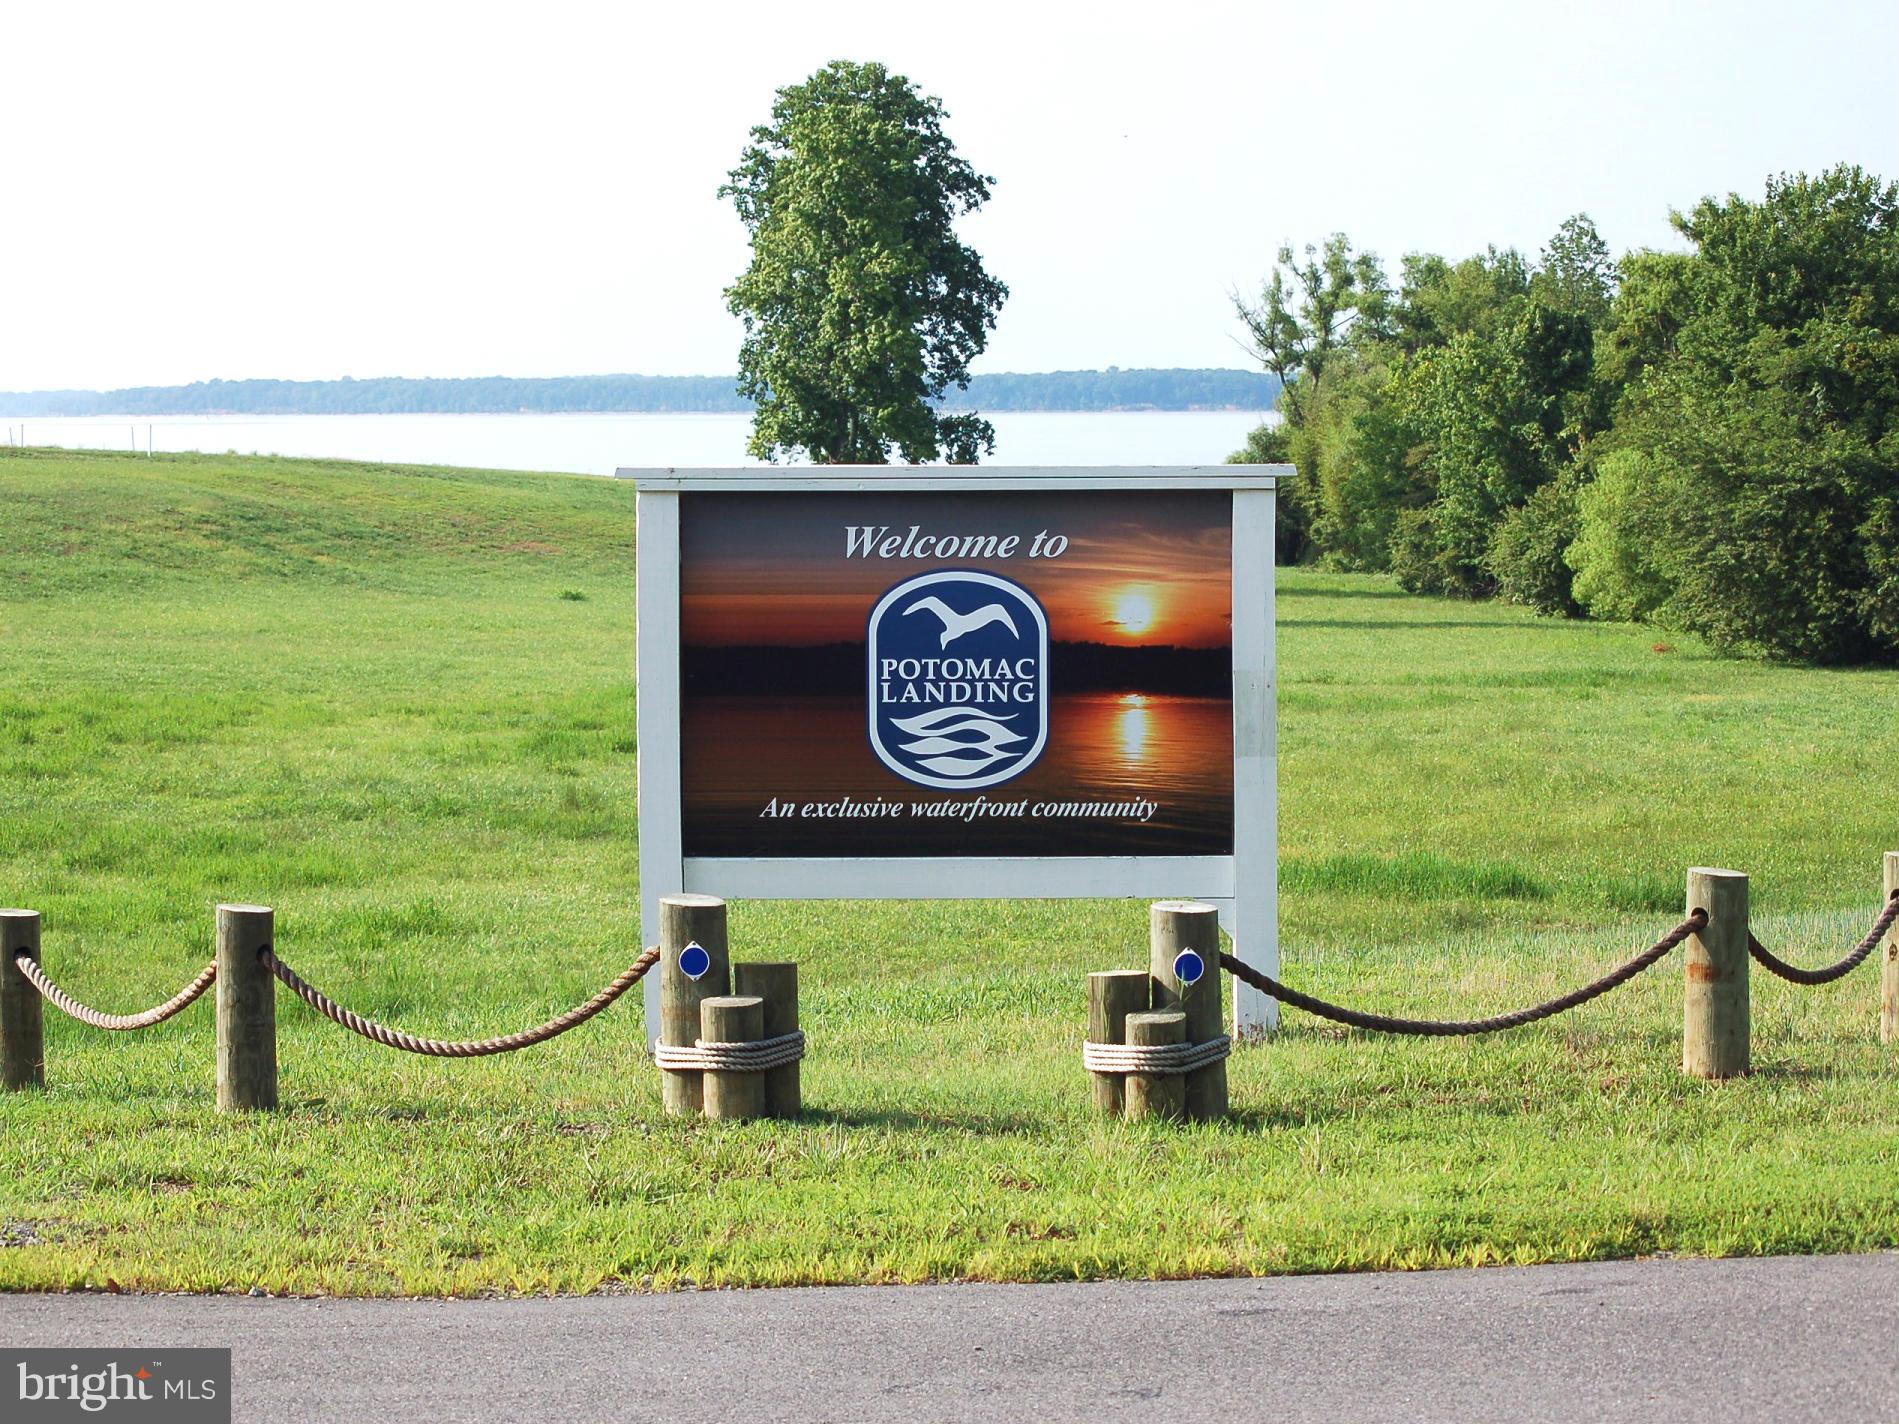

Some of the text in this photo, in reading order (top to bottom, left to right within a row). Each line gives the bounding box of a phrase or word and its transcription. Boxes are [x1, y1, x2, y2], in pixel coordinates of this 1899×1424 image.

[845, 525, 1069, 558] Welcome to
[880, 657, 1035, 680] POTOMAC
[880, 681, 1035, 703] LANDING
[759, 795, 1158, 822] An exclusive waterfront community
